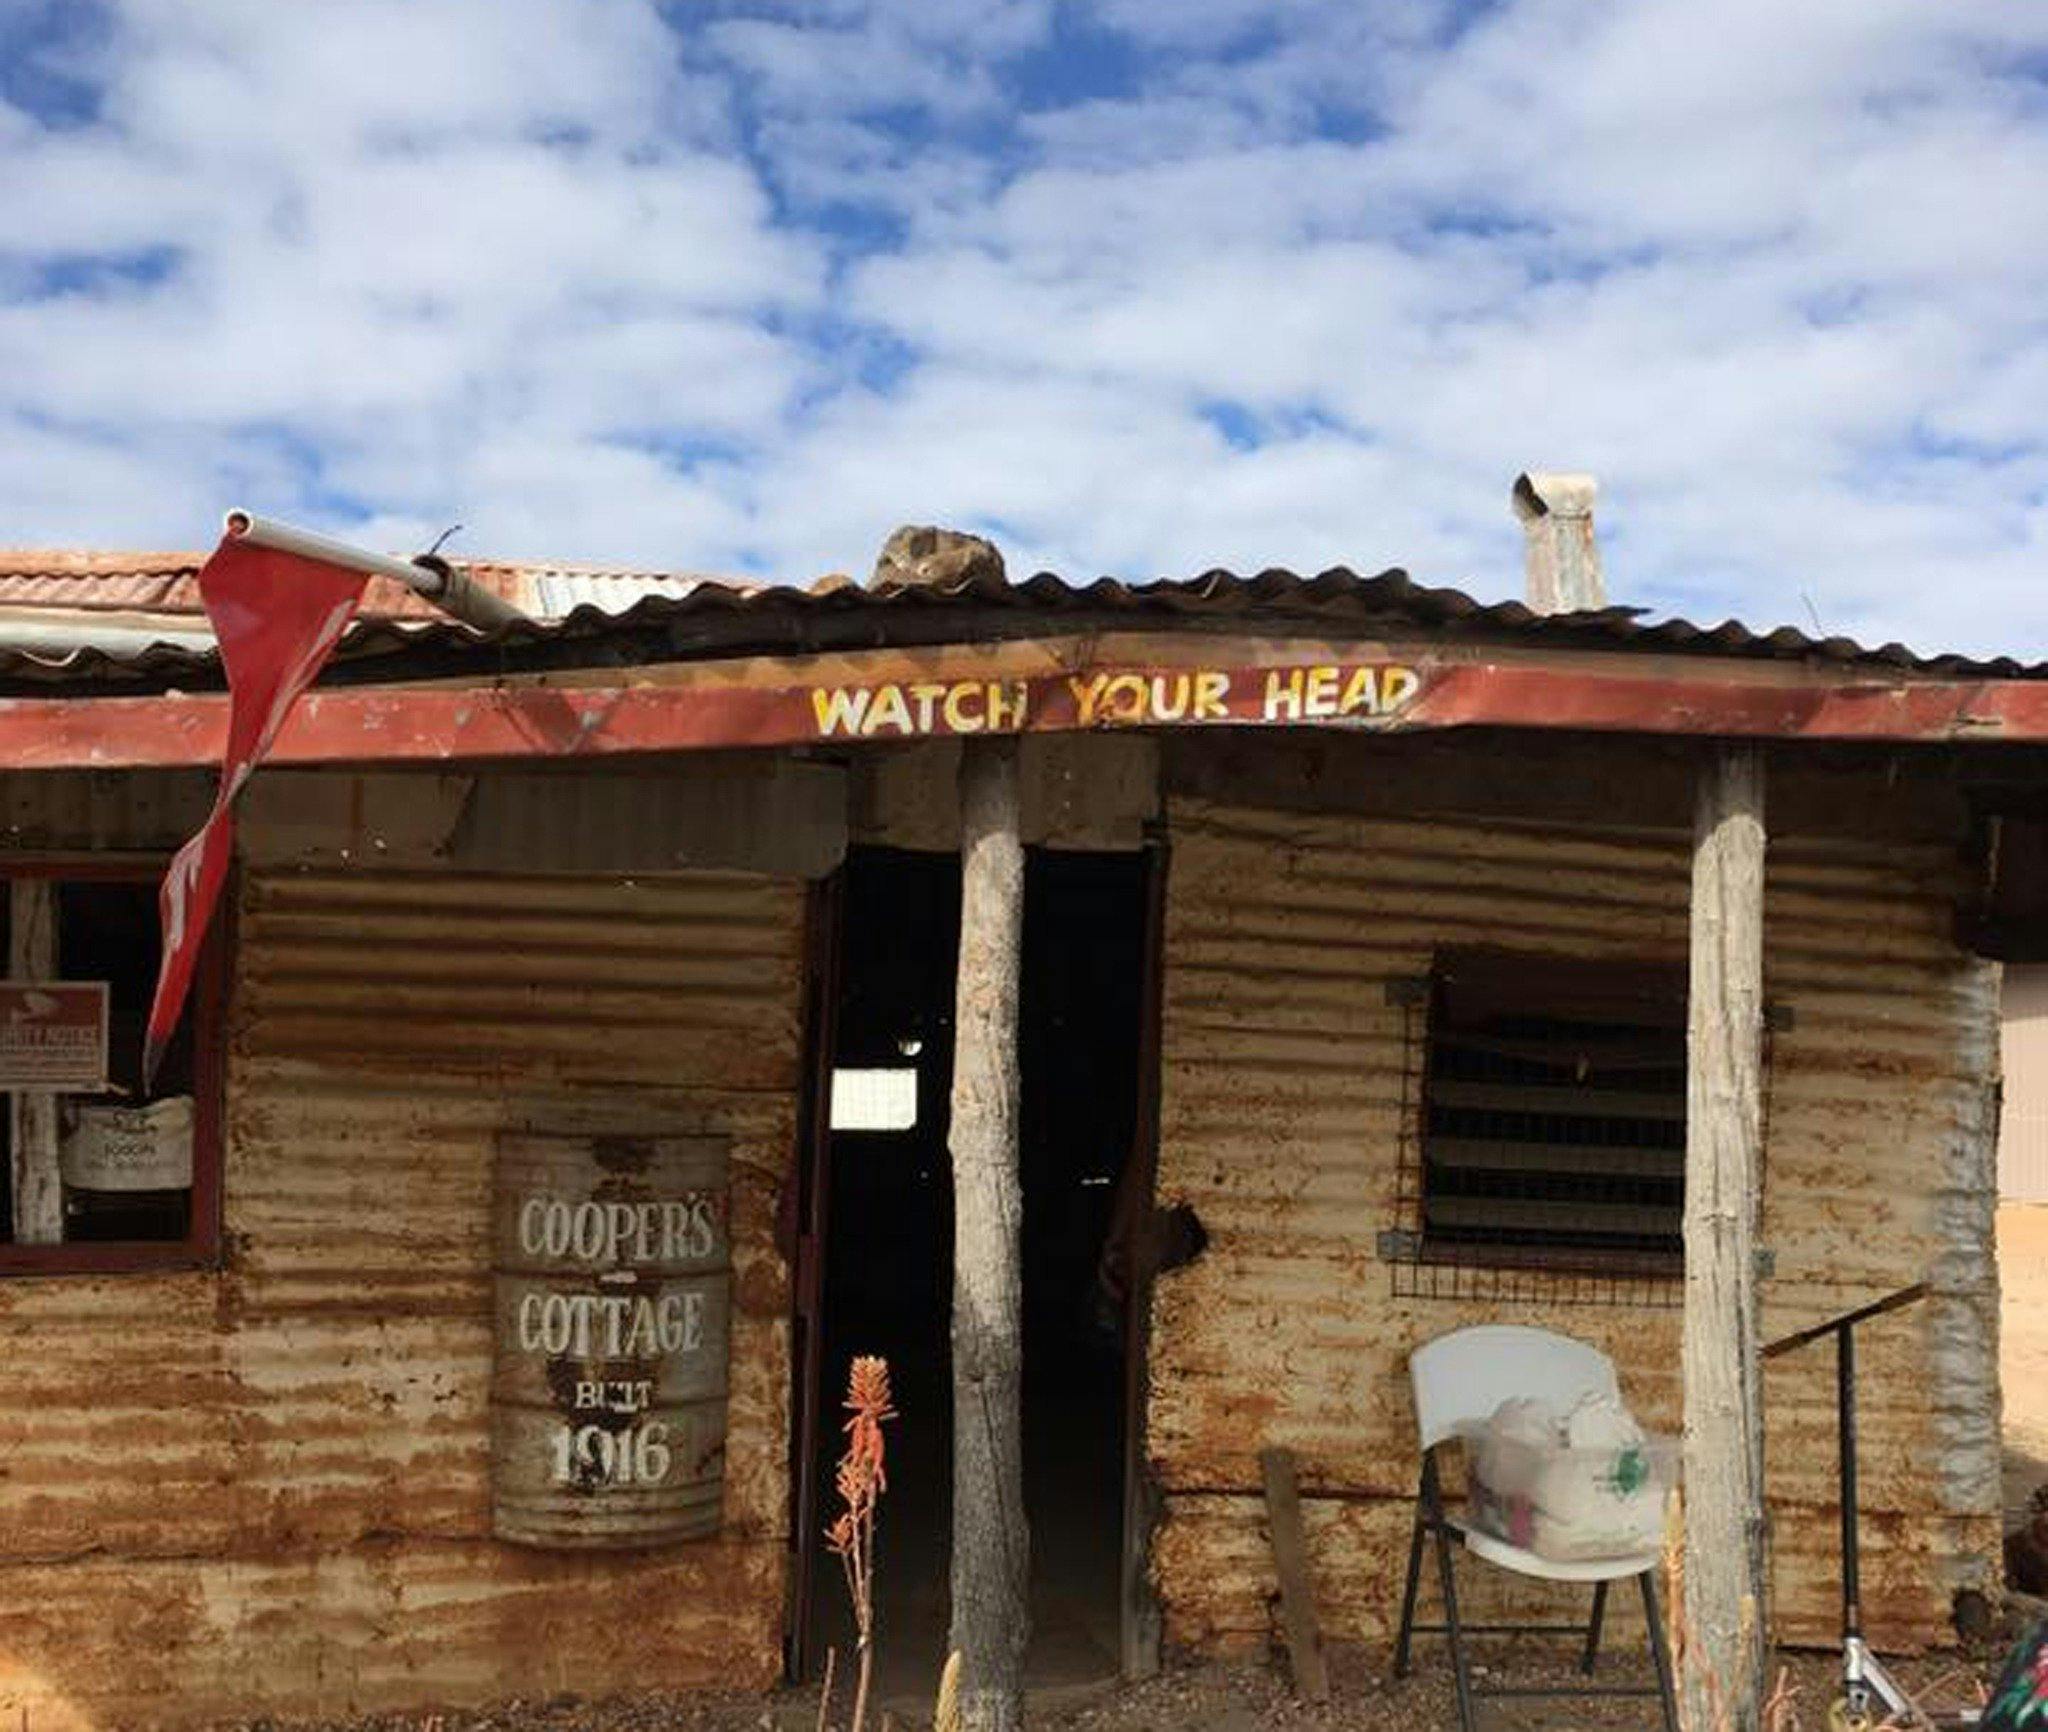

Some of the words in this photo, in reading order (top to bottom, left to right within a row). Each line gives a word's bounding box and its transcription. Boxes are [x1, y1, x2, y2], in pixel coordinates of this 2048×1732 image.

[812, 681, 1027, 736] WATCH
[1069, 670, 1229, 725] YOUR
[1263, 666, 1420, 722] HEAD
[521, 1192, 715, 1262] COOPER'S
[519, 1292, 706, 1358] COTTAGE
[575, 1380, 653, 1414] BULT
[550, 1421, 672, 1484] 1916
